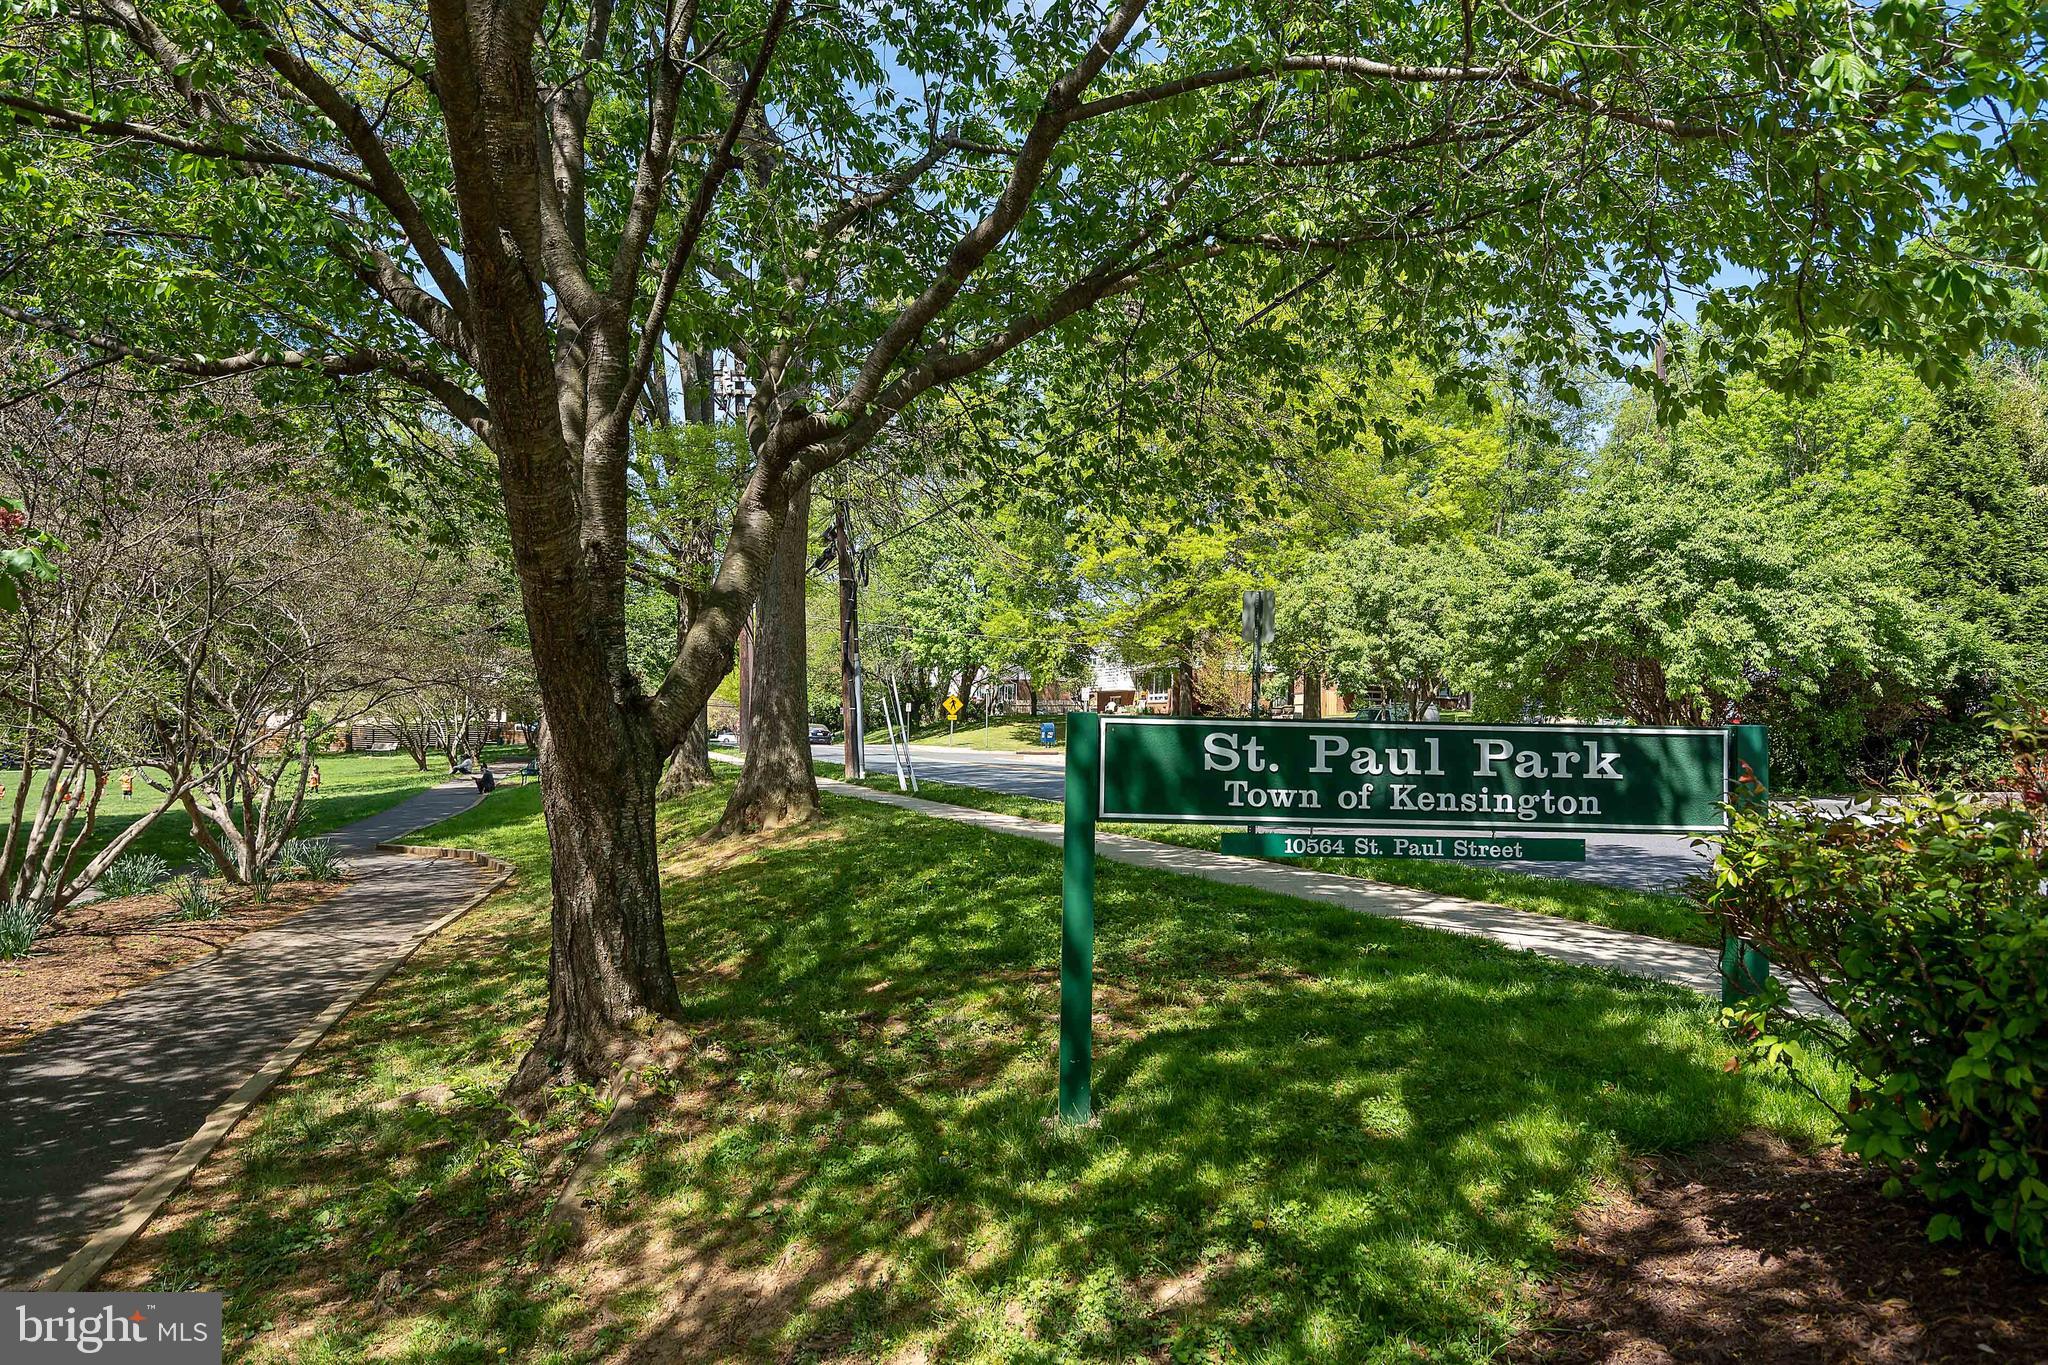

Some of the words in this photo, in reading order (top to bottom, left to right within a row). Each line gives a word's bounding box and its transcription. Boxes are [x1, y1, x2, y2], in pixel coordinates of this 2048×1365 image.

[1203, 732, 1279, 773] St.
[1309, 735, 1445, 776] Paul
[1473, 738, 1624, 780] Park
[1224, 781, 1322, 809] Town
[1337, 783, 1374, 810] of
[1389, 784, 1602, 821] Kensington
[1283, 838, 1345, 854] 10564
[1354, 838, 1384, 857] St.
[1393, 839, 1444, 858] Paul
[1454, 840, 1523, 858] Street
